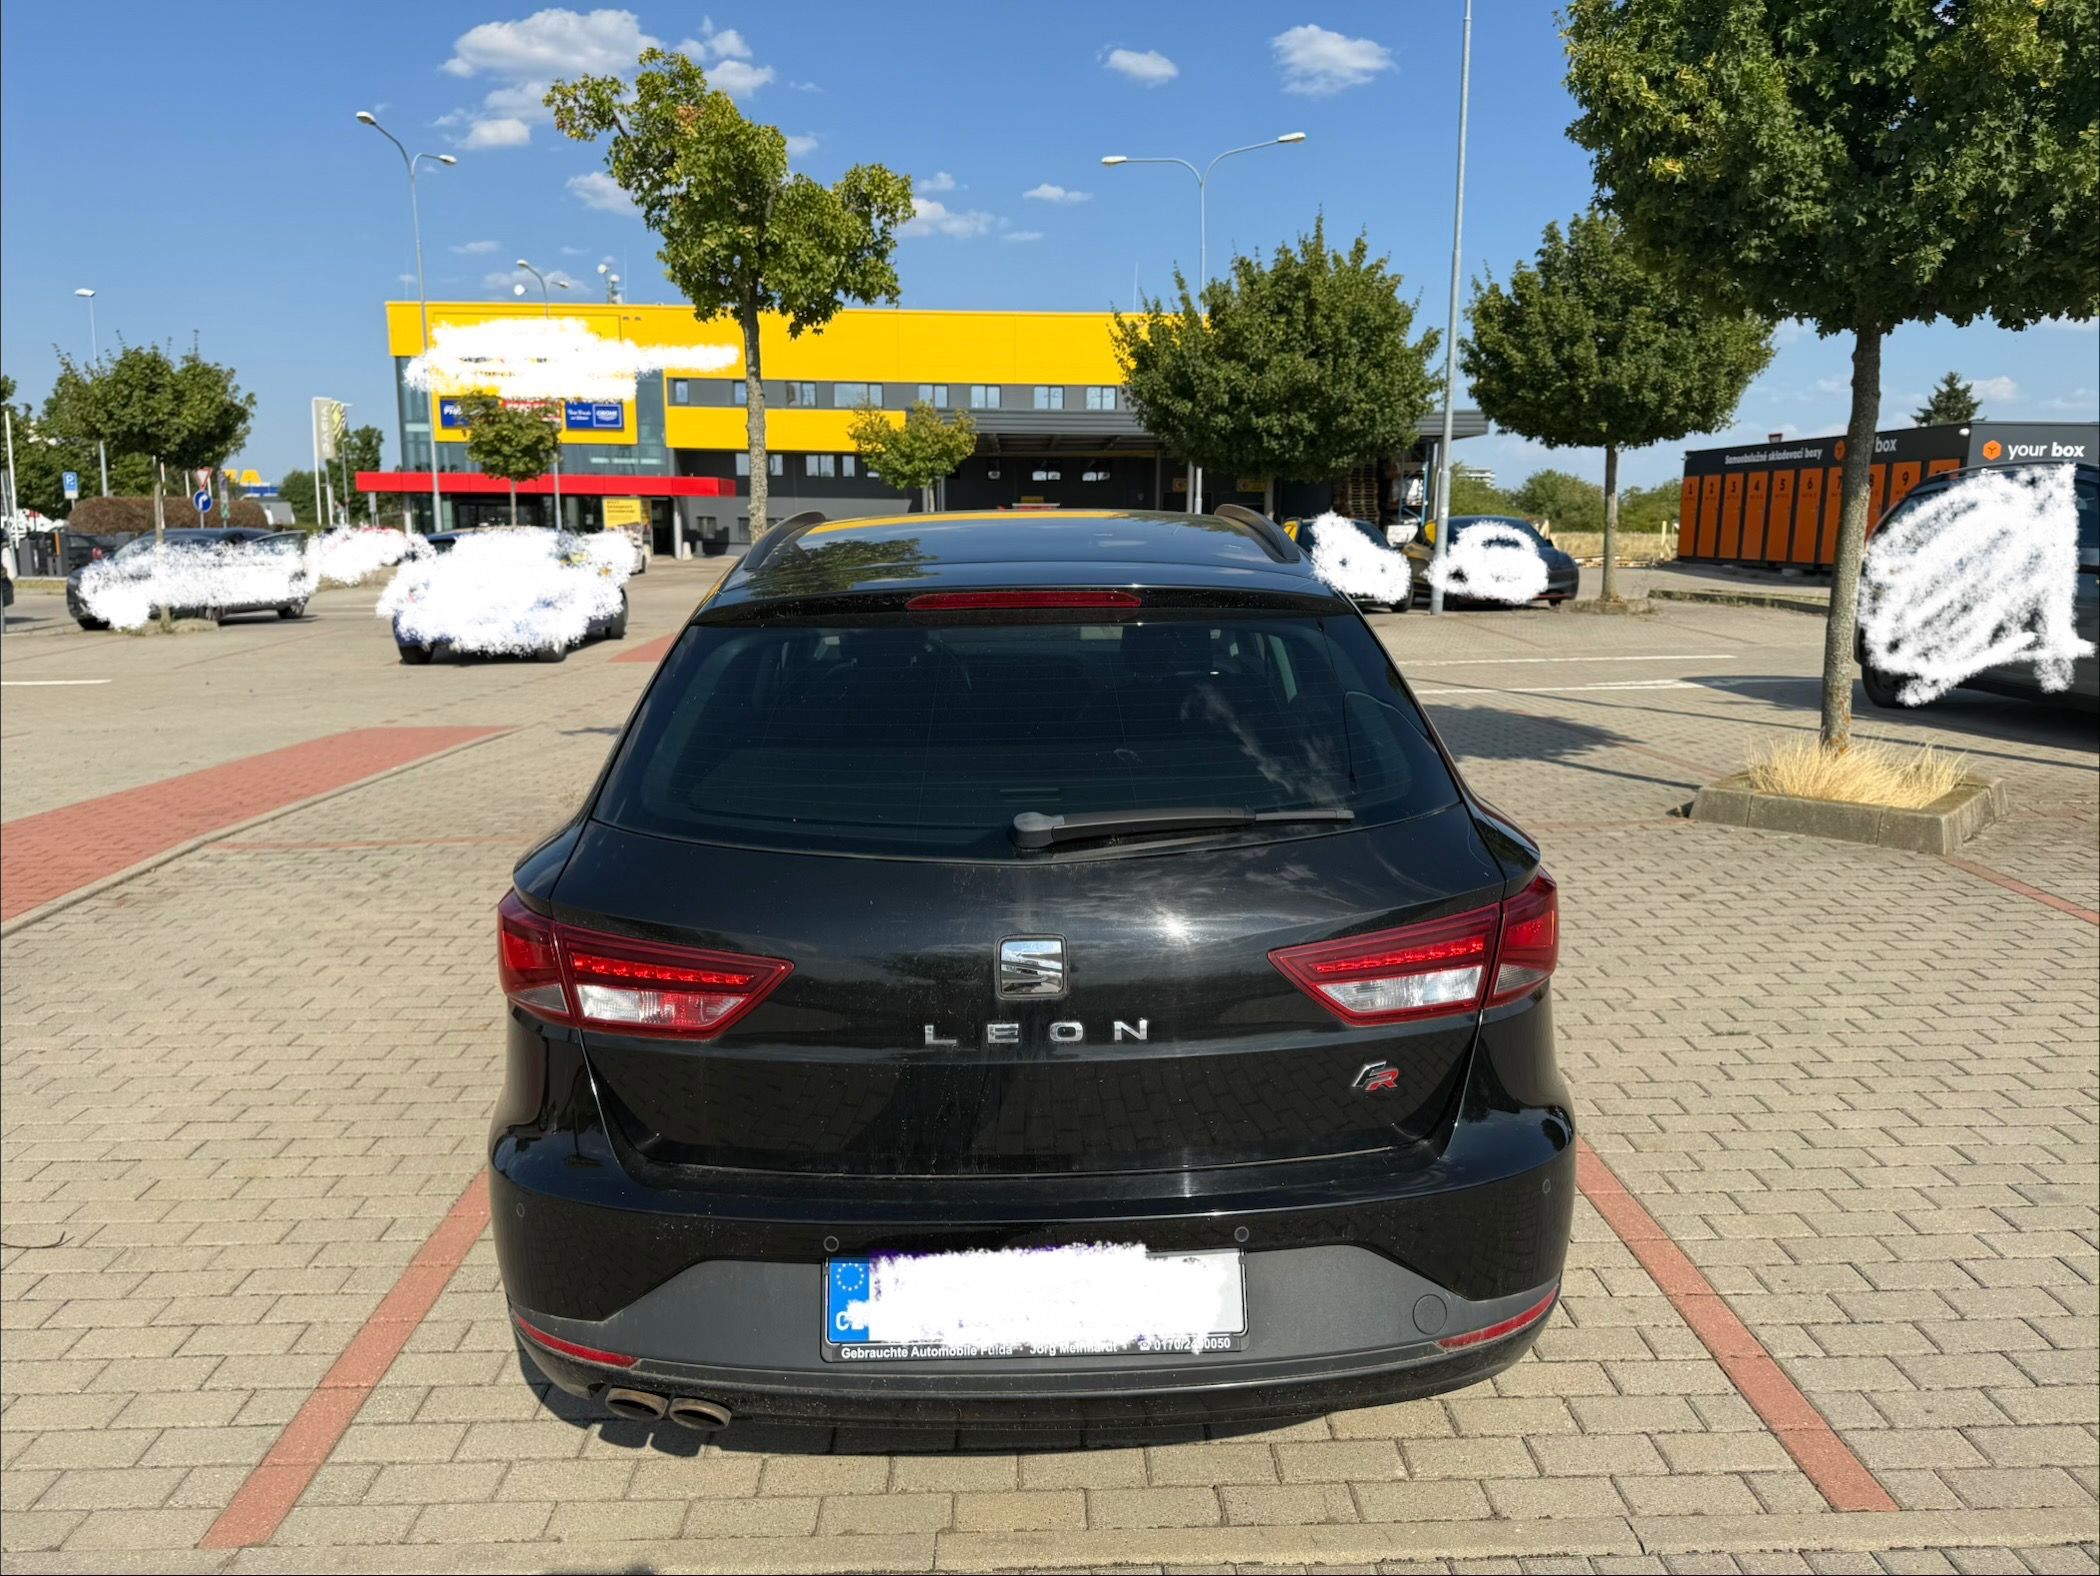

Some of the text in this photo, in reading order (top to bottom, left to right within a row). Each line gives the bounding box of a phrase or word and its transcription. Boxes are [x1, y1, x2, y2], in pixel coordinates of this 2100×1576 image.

[1874, 437, 1897, 453] box
[2008, 442, 2085, 460] your box
[1805, 448, 1823, 460] boxy
[1754, 480, 1760, 491] 4
[1780, 479, 1785, 491] 5
[1807, 477, 1813, 490] 6
[1903, 471, 1909, 486] 9
[925, 1018, 1149, 1045] LEON
[1352, 1061, 1399, 1091] FR
[835, 1310, 865, 1331] C
[841, 1347, 908, 1359] Gebrauchte
[911, 1345, 976, 1357] Automobile
[981, 1343, 1013, 1355] Fulda
